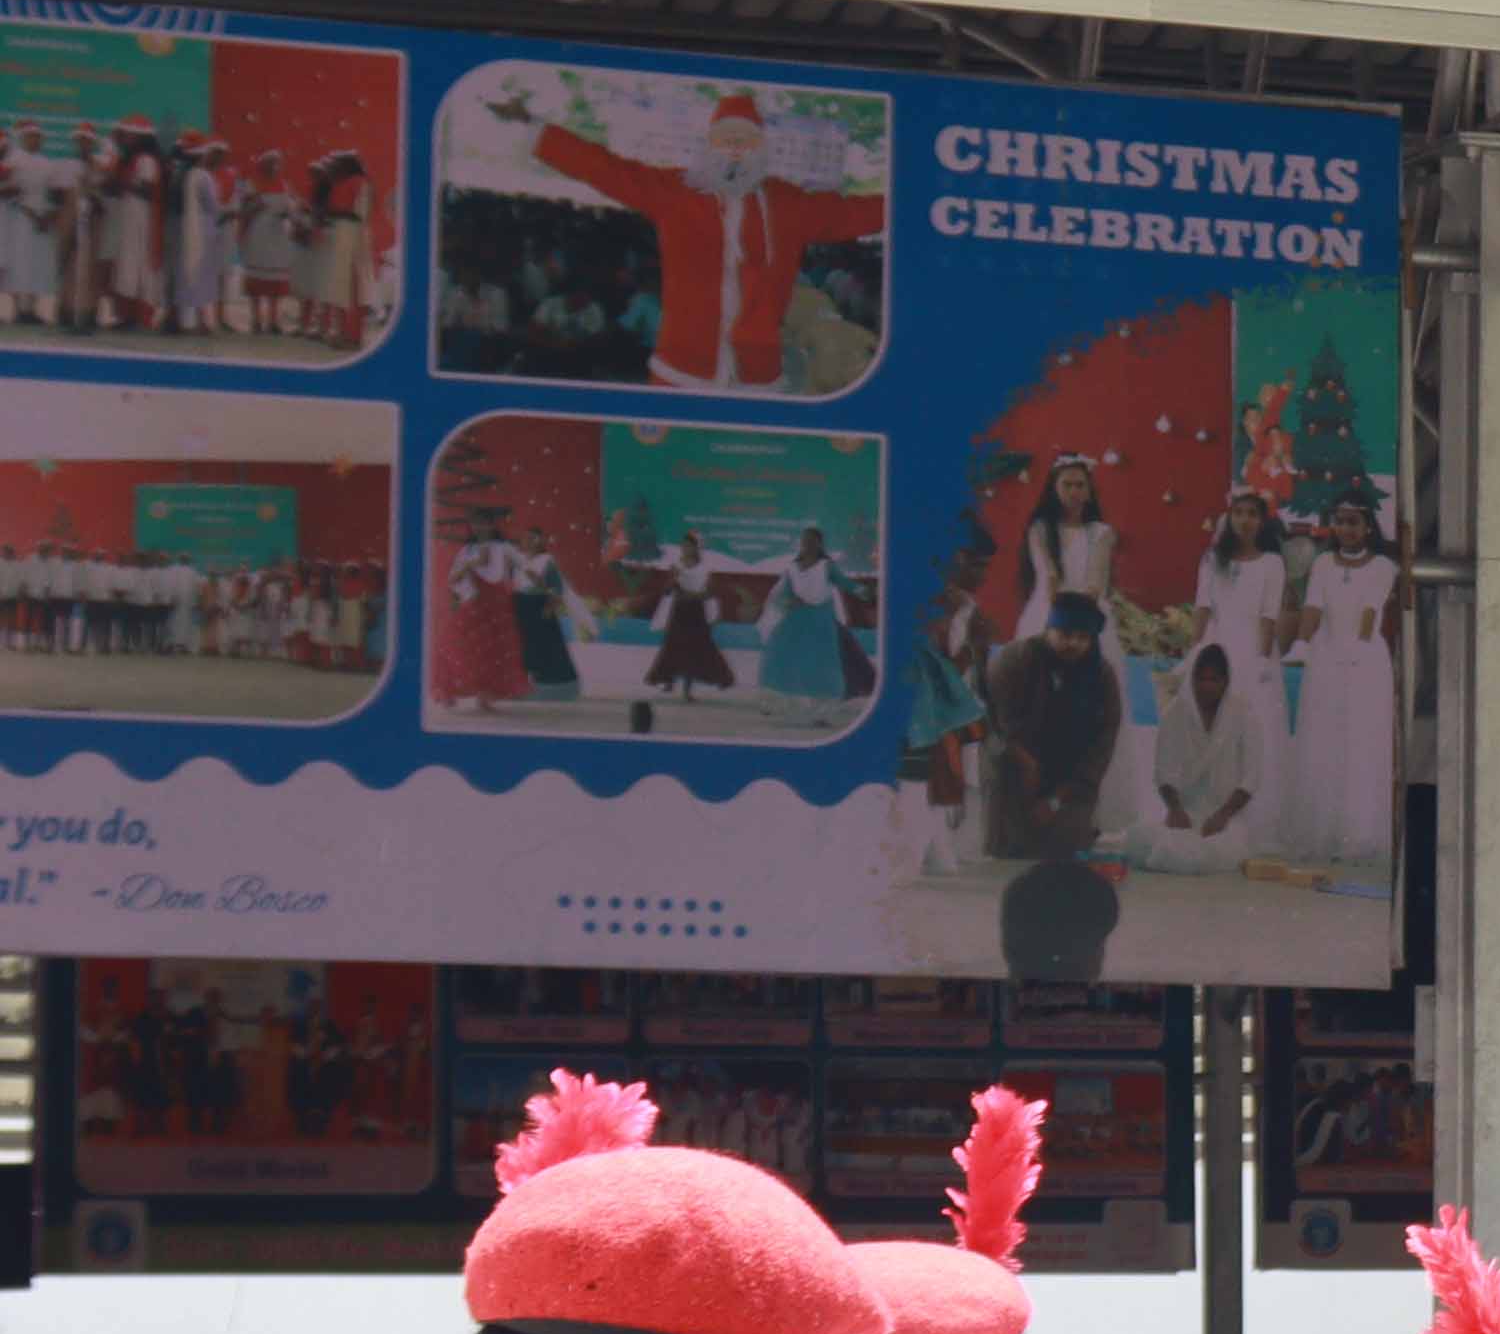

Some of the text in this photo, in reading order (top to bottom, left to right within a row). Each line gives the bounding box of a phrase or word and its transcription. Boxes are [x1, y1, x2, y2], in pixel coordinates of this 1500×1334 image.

[933, 123, 1360, 204] CHRISTMAS
[929, 195, 1364, 268] CELEBRATION
[8, 808, 157, 851] you do,
[114, 873, 206, 914] Don
[213, 873, 329, 915] Bosco
